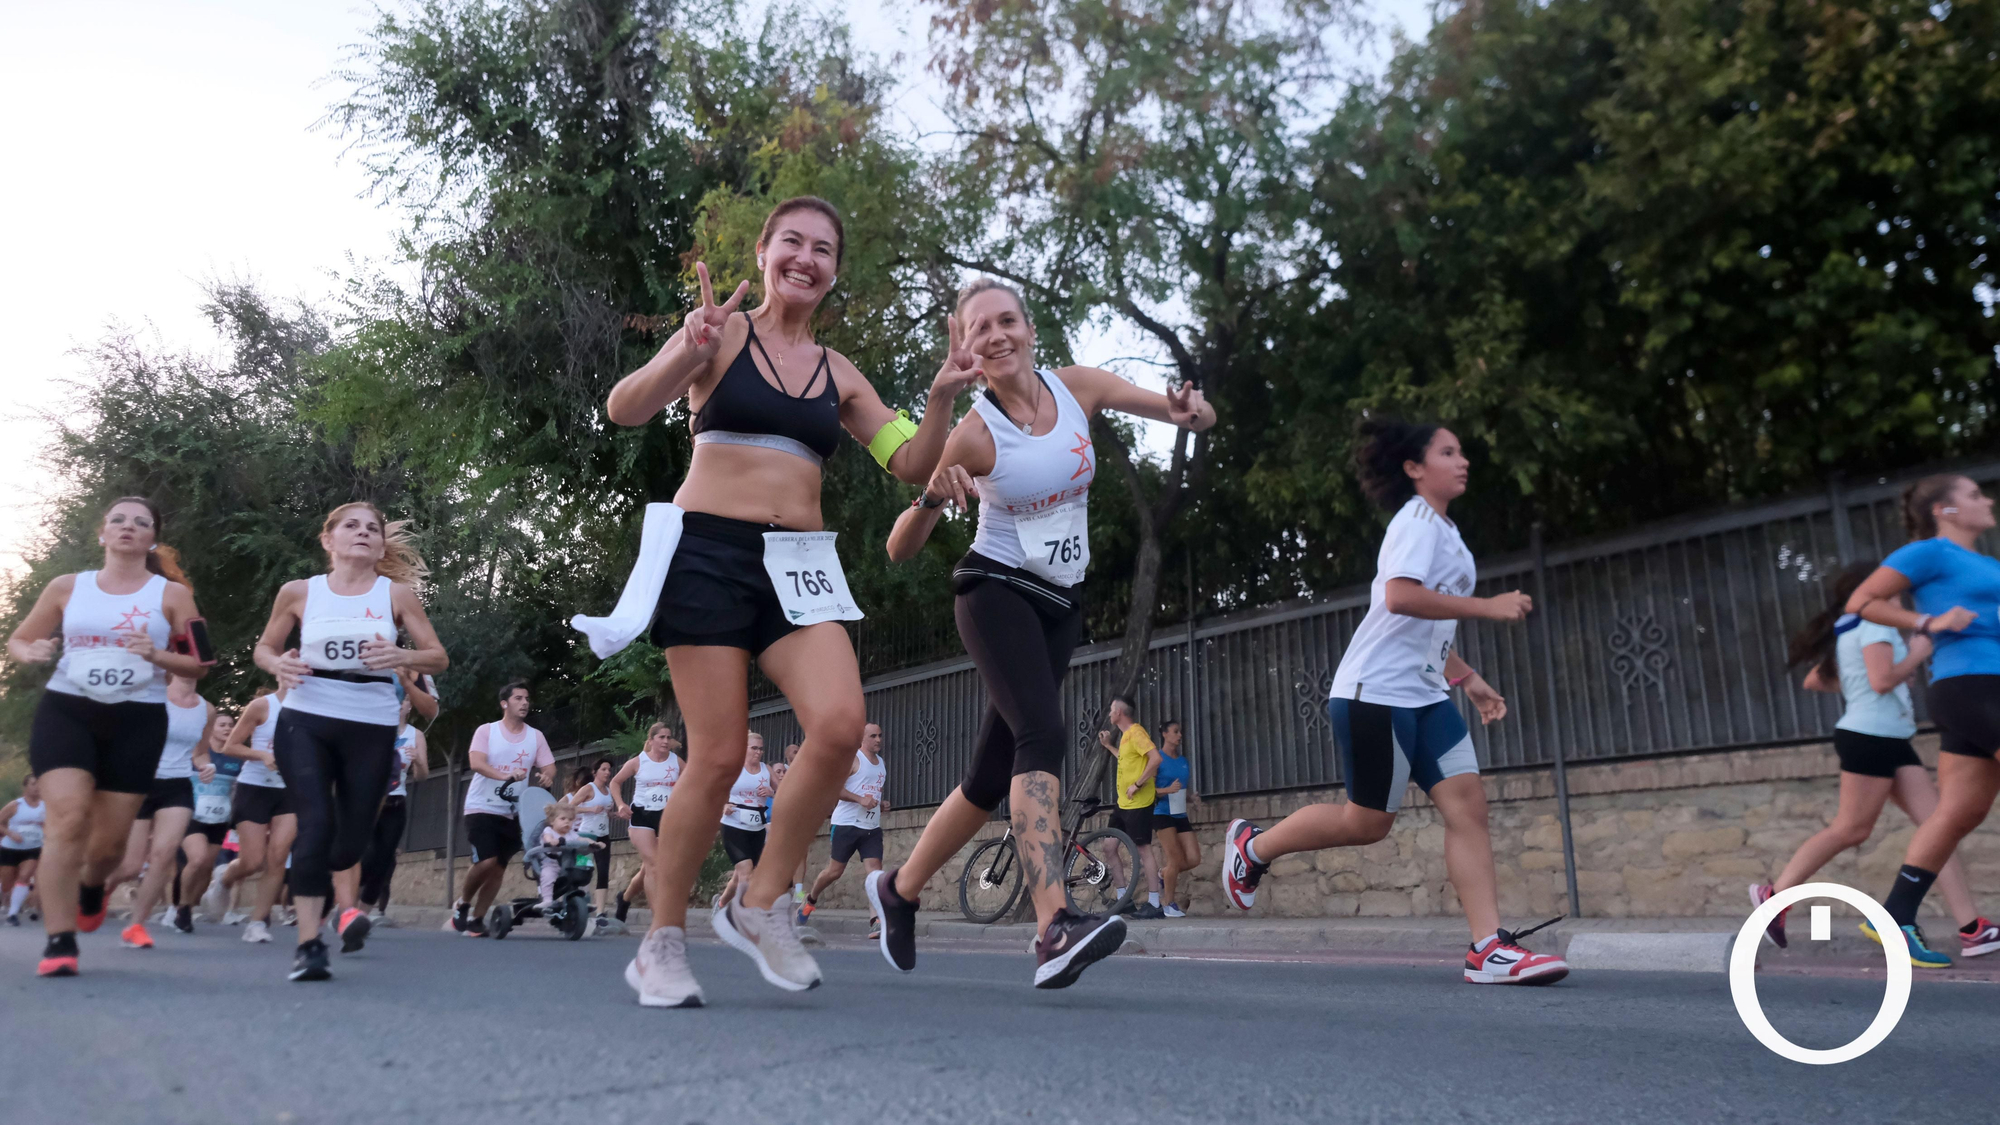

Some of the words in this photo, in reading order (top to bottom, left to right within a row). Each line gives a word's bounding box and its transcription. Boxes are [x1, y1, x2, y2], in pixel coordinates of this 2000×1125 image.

[1044, 535, 1081, 565] 765
[785, 569, 835, 598] 766
[88, 668, 134, 686] 562
[651, 793, 669, 803] 841
[749, 814, 760, 823] 76
[865, 810, 876, 820] 77
